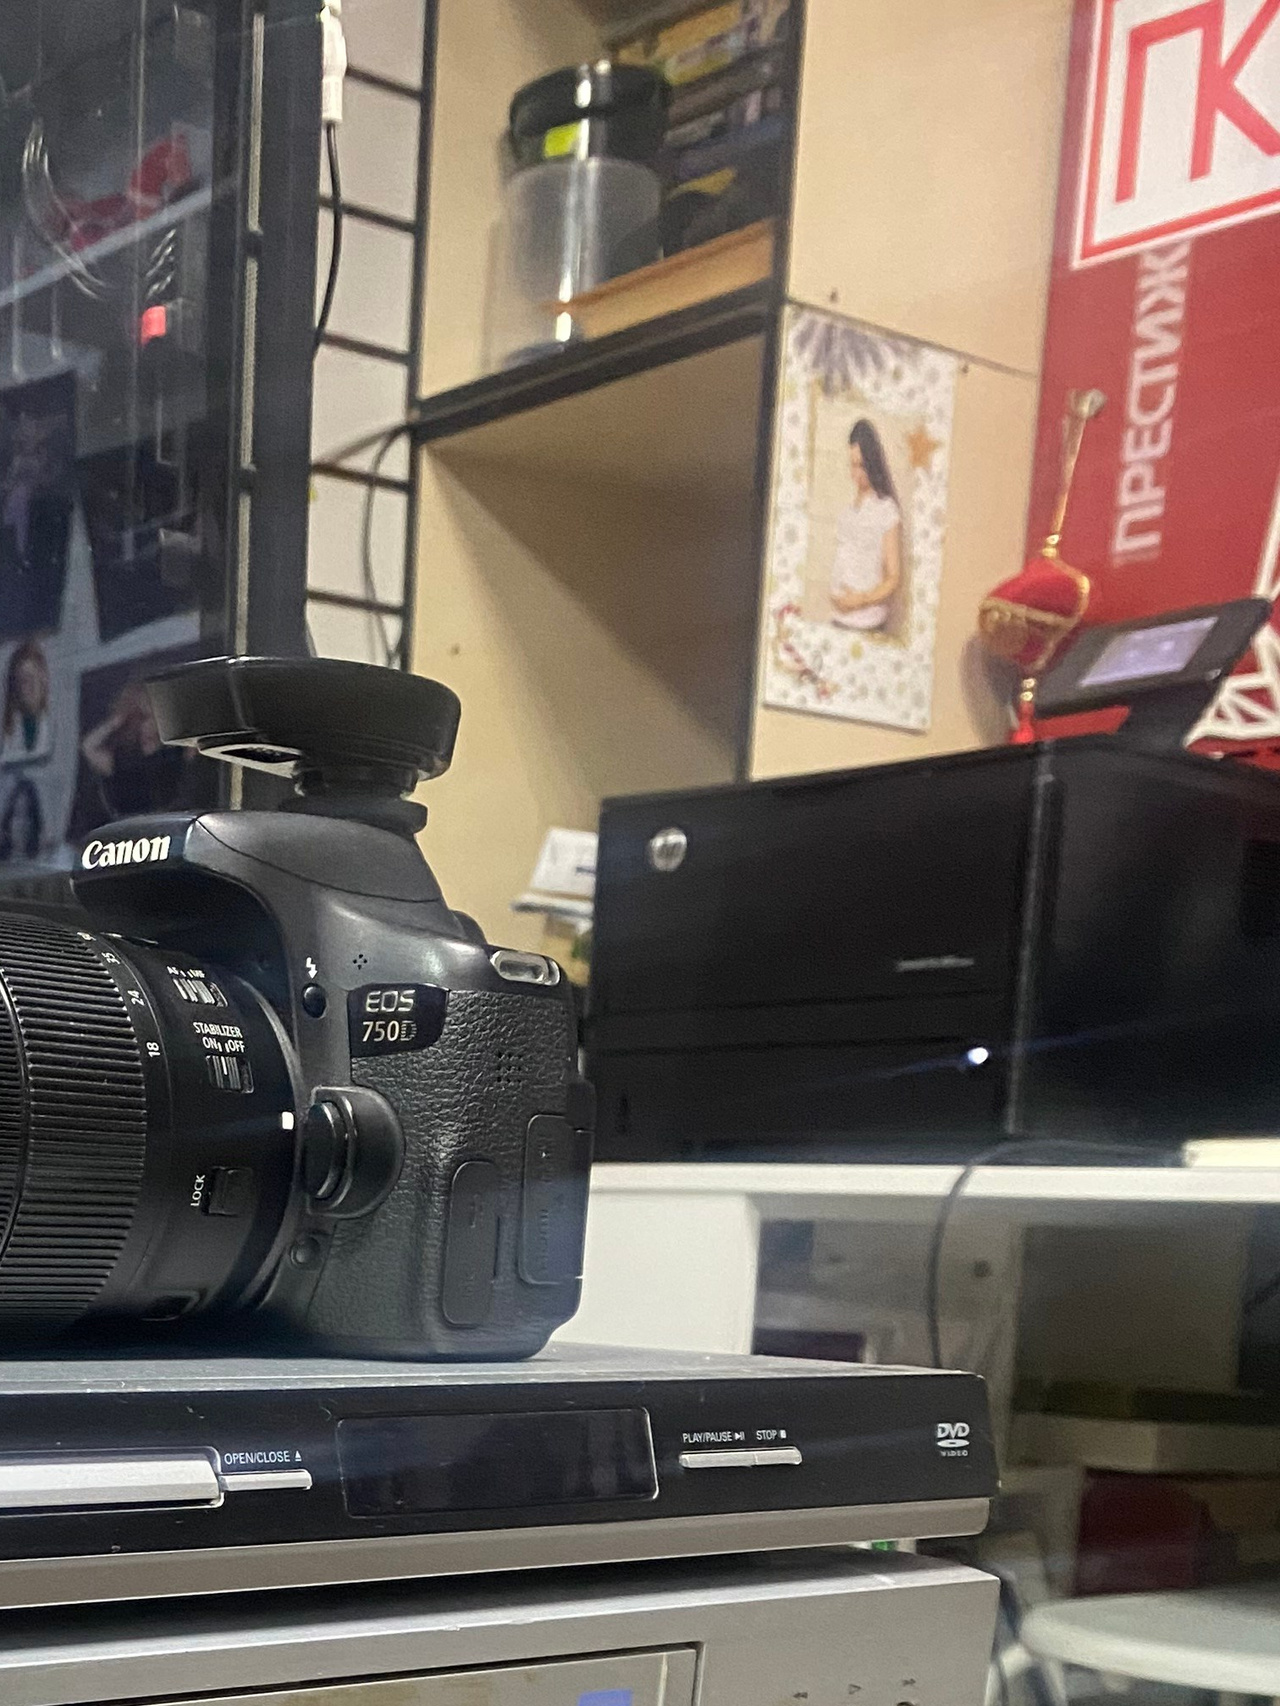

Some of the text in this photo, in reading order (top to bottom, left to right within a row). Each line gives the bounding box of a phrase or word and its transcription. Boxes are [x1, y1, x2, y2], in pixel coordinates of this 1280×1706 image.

[1113, 239, 1194, 566] ПРЕСТИЖ
[81, 834, 171, 870] Canon
[101, 951, 120, 965] 35
[127, 989, 145, 1006] 24
[365, 988, 416, 1013] EOS
[192, 1020, 244, 1039] STABILIZER
[362, 1019, 418, 1042] 750D
[146, 1041, 161, 1058] 18
[202, 1036, 246, 1053] ON OFF
[190, 1174, 206, 1207] LOCK
[682, 1429, 778, 1444] PLAY/PAUSE STOP
[936, 1421, 971, 1439] DVD
[223, 1449, 292, 1466] OPEN/CLOSE
